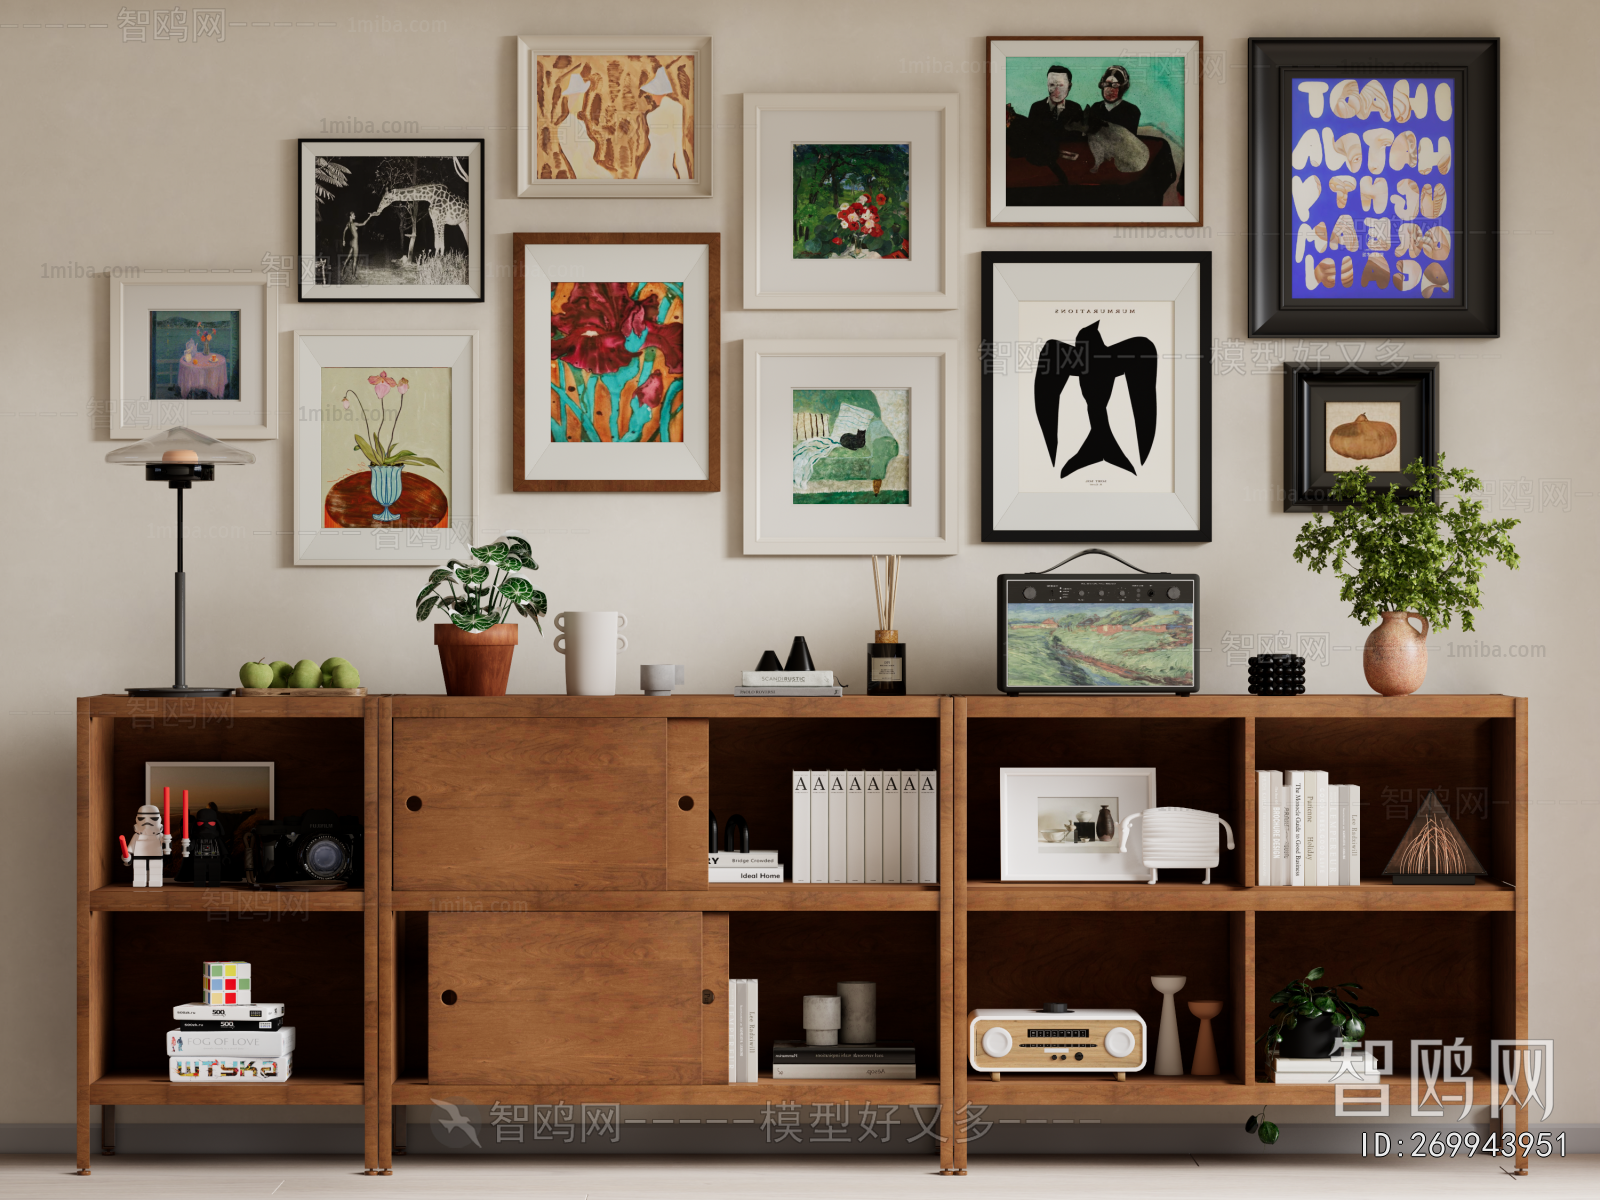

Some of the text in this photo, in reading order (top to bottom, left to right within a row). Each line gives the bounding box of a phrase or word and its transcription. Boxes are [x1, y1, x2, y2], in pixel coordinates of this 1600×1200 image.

[795, 776, 807, 791] A
[813, 776, 825, 791] A
[831, 776, 844, 791] A
[849, 776, 861, 791] A
[867, 776, 880, 791] A
[886, 776, 898, 791] A
[904, 776, 916, 791] A
[922, 776, 934, 791] A
[1305, 837, 1314, 860] Holiday
